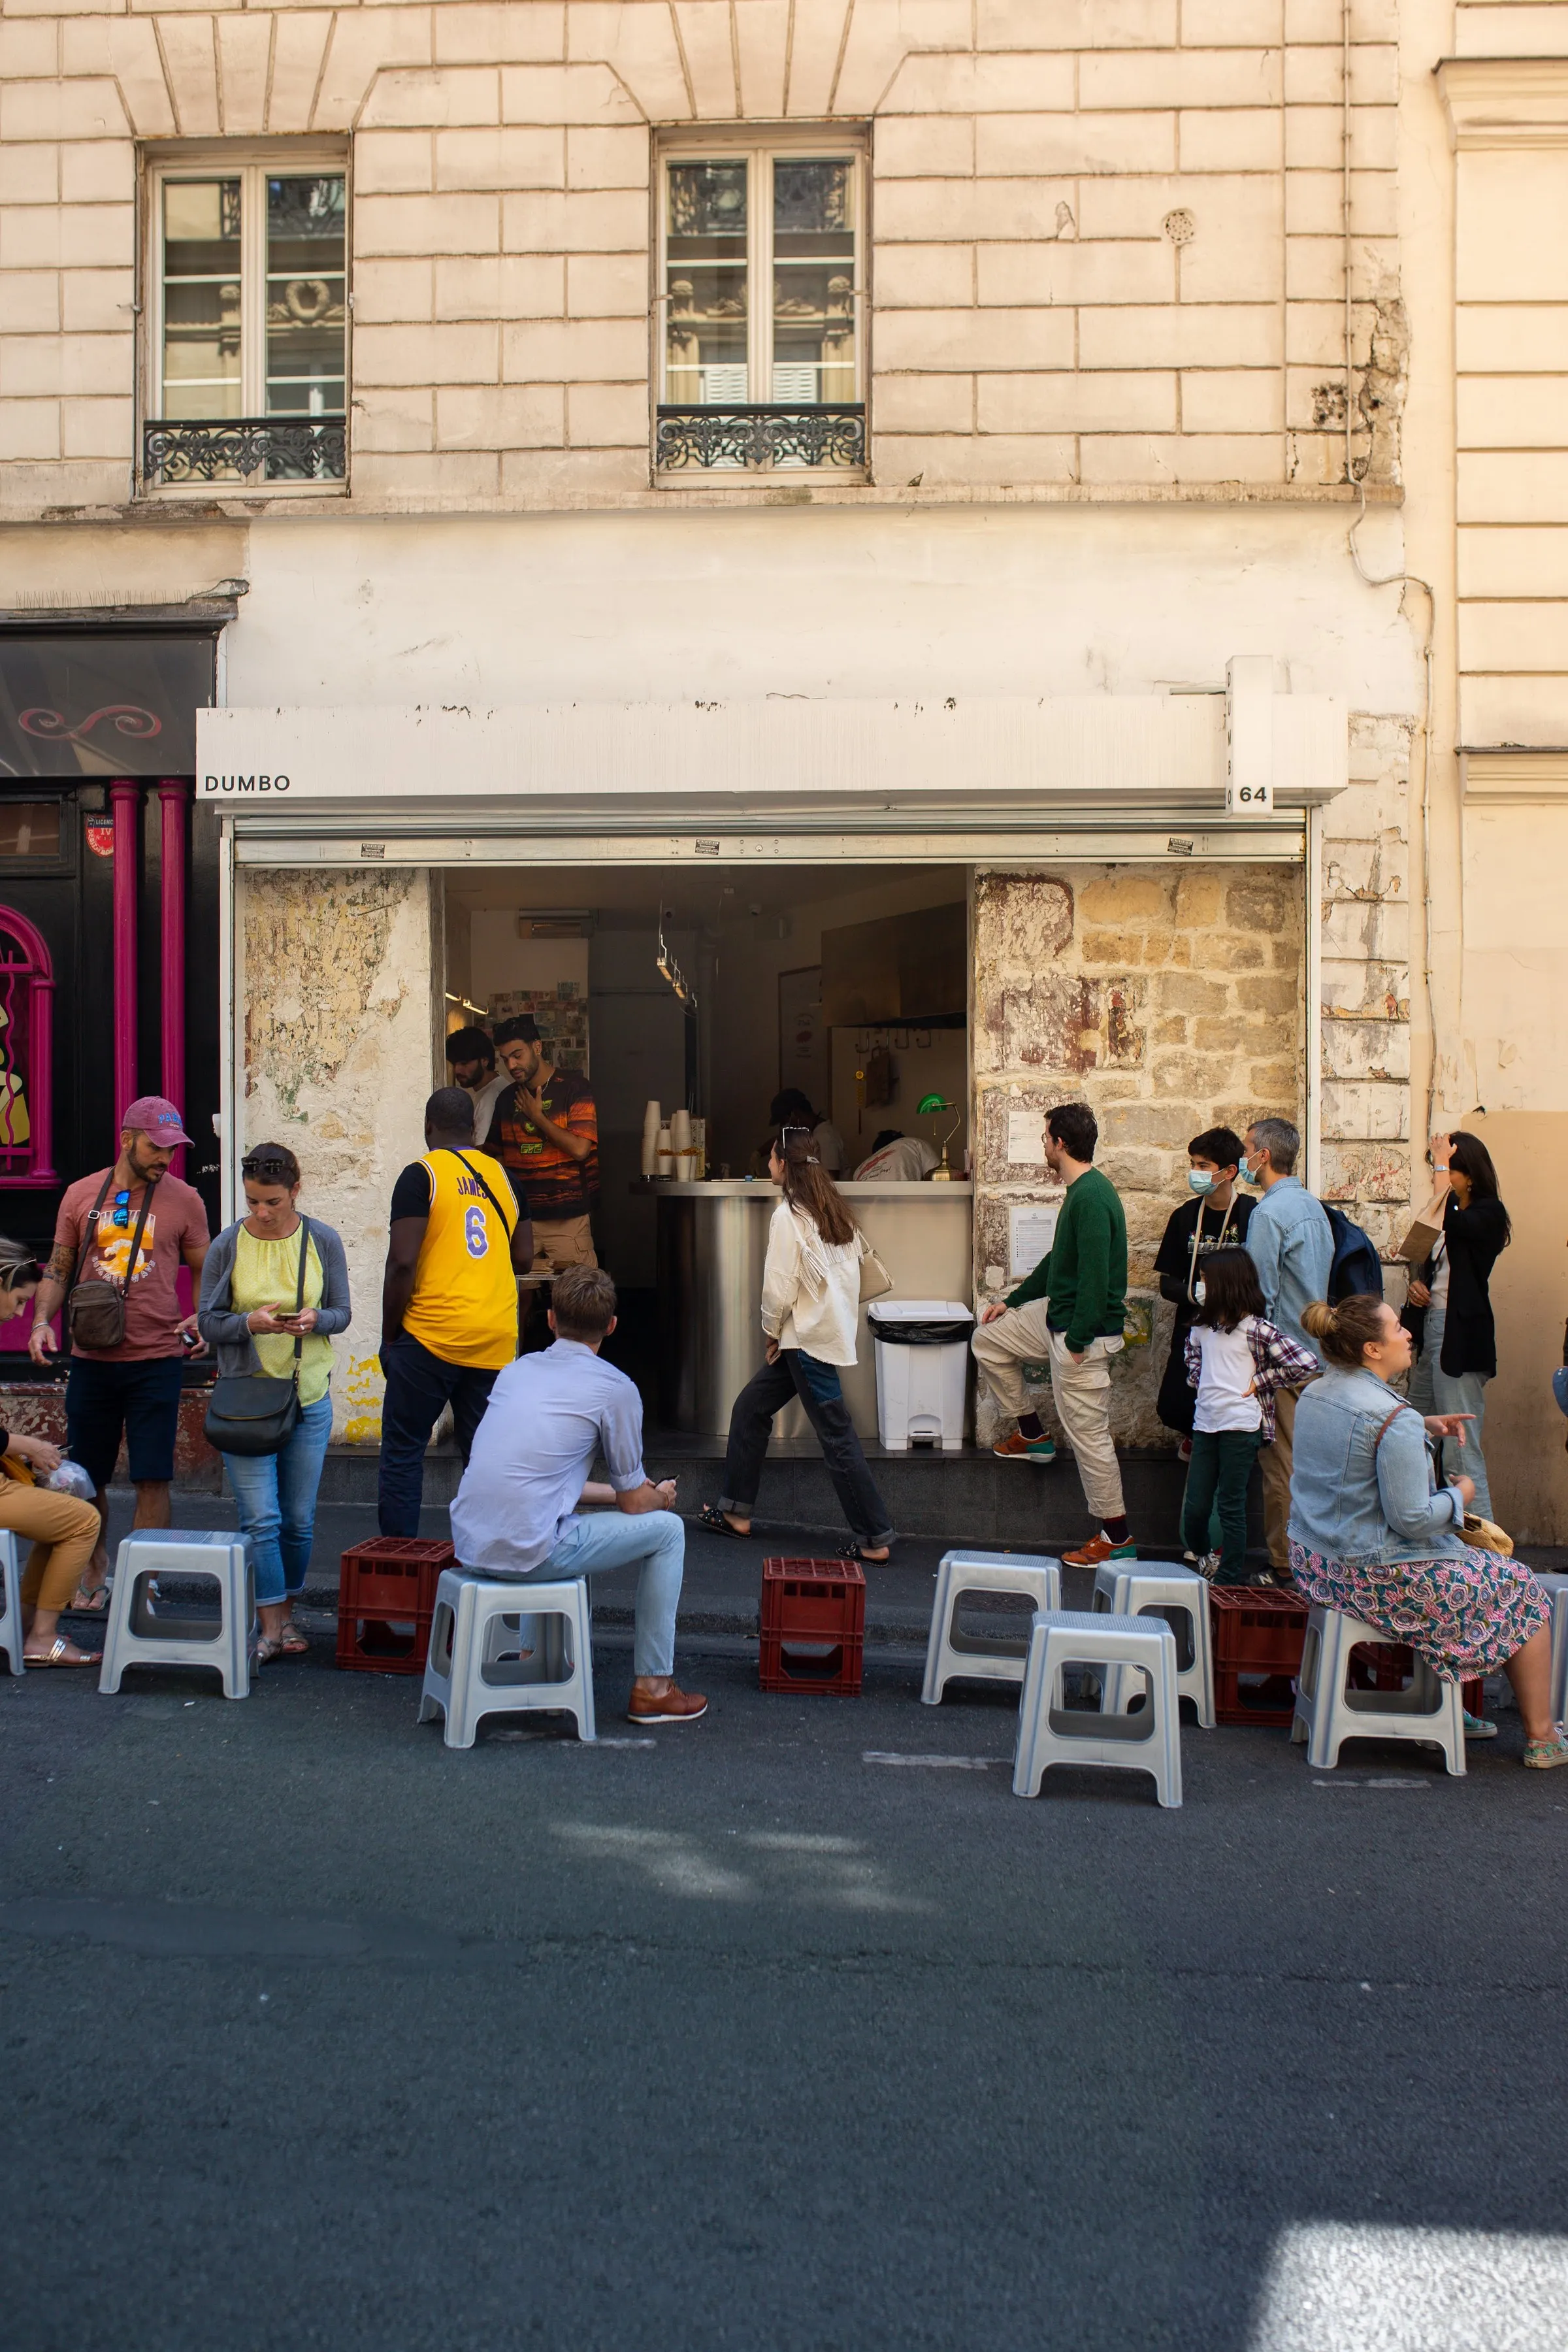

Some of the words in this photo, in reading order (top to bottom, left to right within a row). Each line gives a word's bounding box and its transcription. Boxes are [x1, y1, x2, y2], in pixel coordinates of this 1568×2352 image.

[205, 775, 290, 791] DUMBO
[1239, 786, 1267, 803] 64
[465, 1205, 489, 1259] 6
[131, 1259, 155, 1283] WAVE
[1258, 1574, 1273, 1585] N
